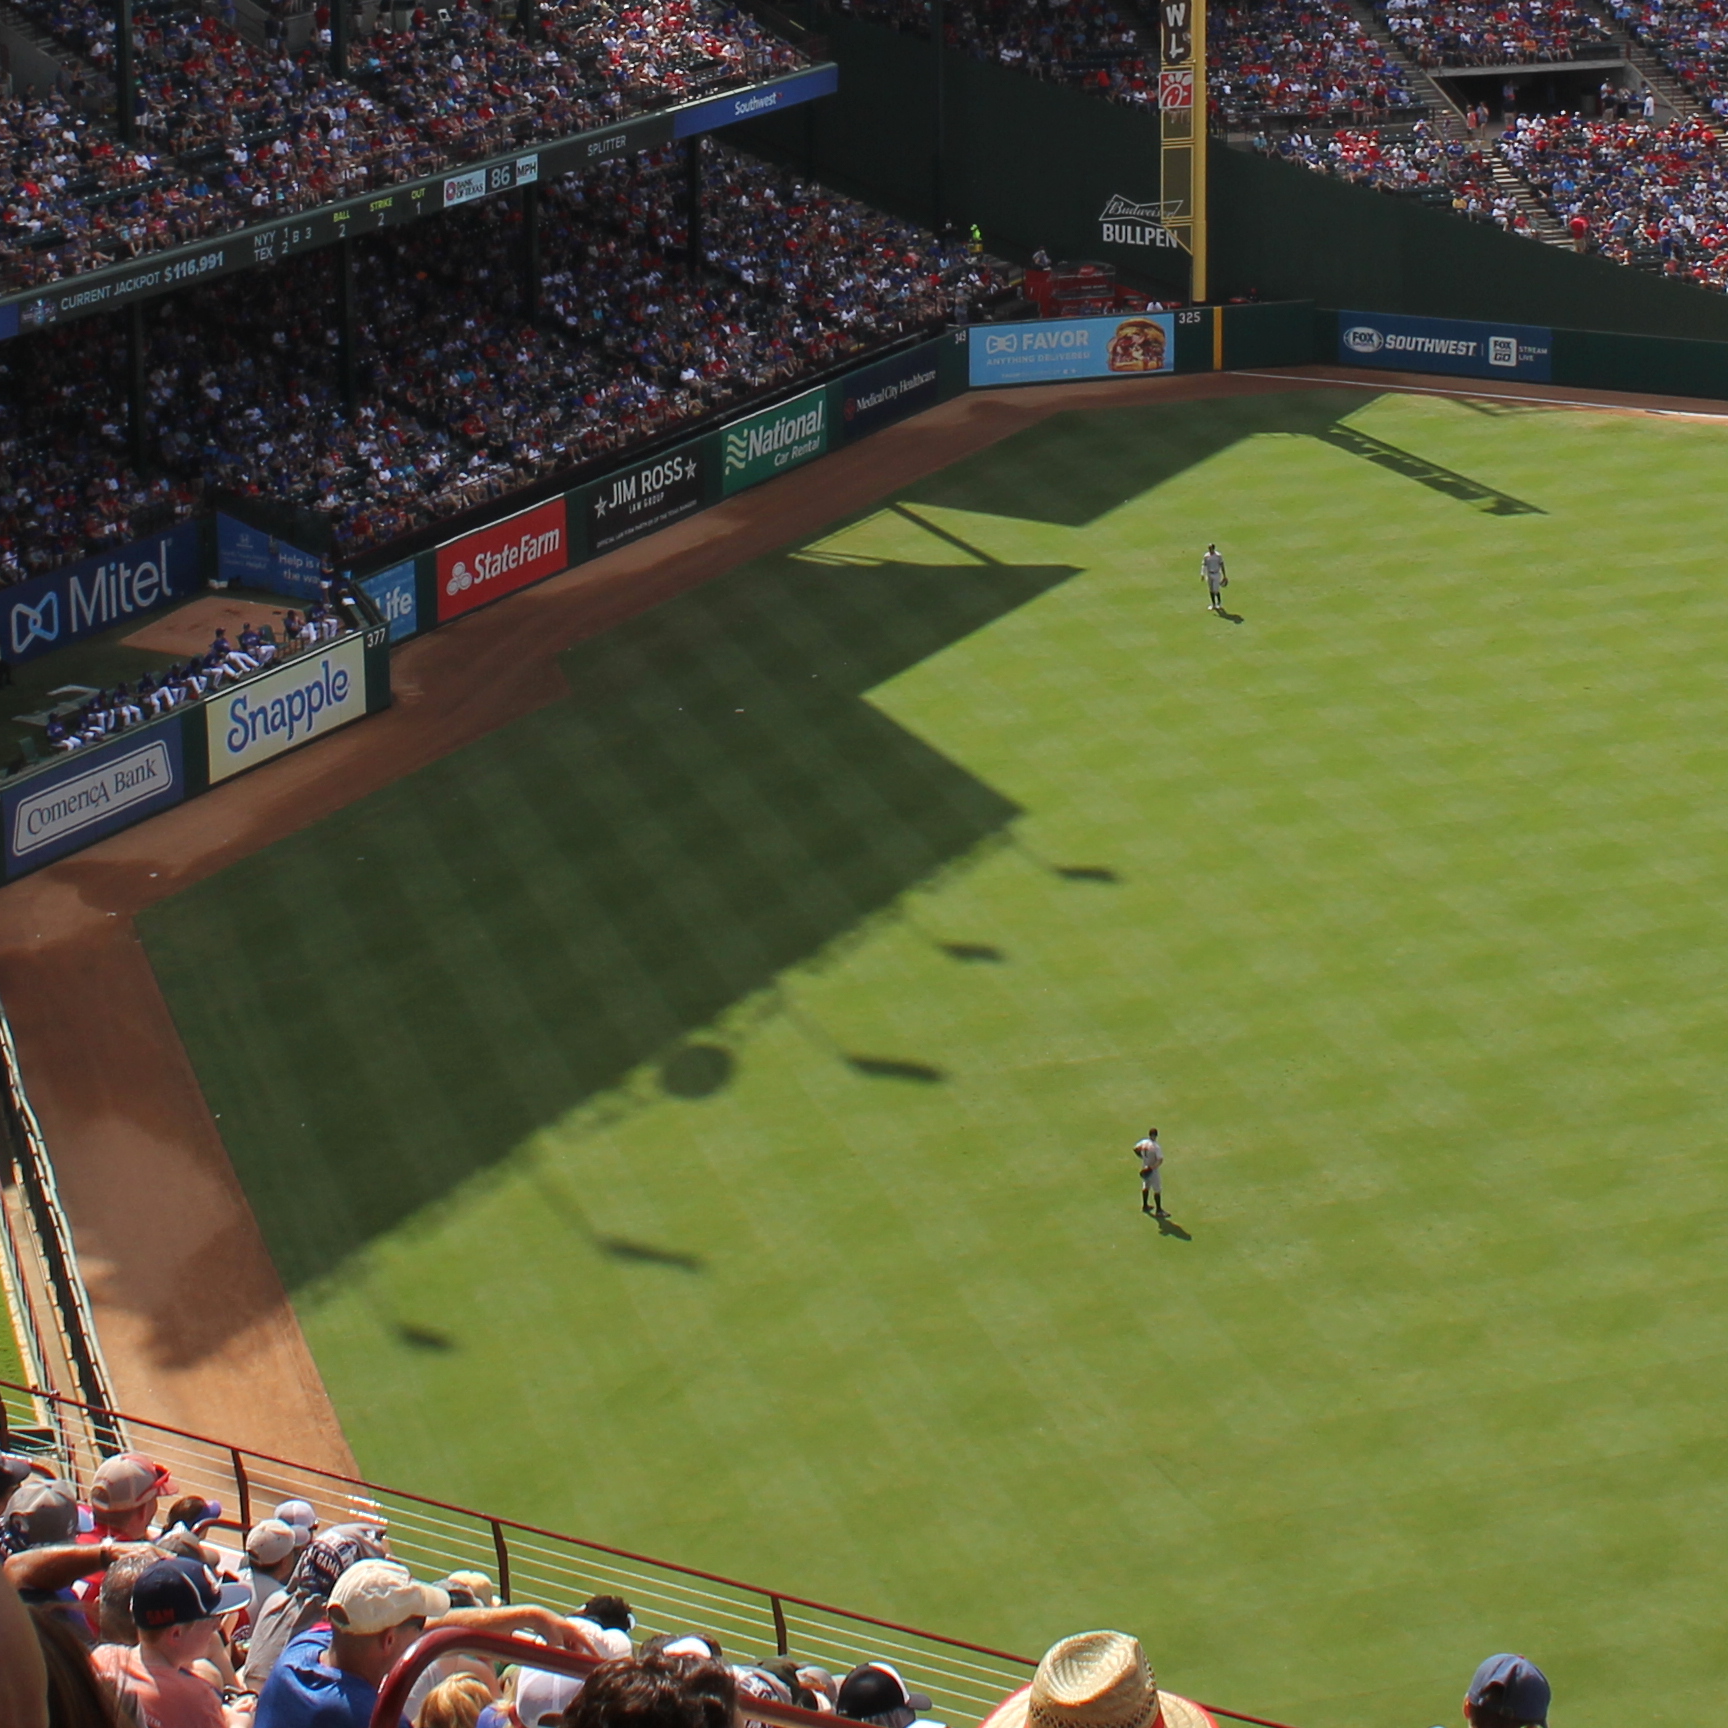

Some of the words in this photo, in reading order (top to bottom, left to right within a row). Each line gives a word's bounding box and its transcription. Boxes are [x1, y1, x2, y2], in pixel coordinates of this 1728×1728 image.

[735, 92, 776, 115] Southwest
[587, 135, 625, 157] SPLITTER
[491, 169, 510, 188] 86
[517, 162, 536, 178] MPH
[1102, 223, 1177, 248] BULLPEN
[61, 285, 110, 311] CURRENT
[113, 272, 159, 296] JACKPOT
[164, 251, 222, 283] $116,991
[1179, 312, 1201, 324] 325
[1023, 329, 1088, 350] FAVOR
[1385, 334, 1476, 356] SOUTHWEST
[857, 388, 883, 412] Medical
[884, 385, 898, 400] City
[899, 370, 935, 390] Healthcare
[748, 400, 823, 461] National
[774, 450, 789, 467] Car
[791, 437, 819, 457] Rental
[609, 475, 635, 509] JIM
[641, 457, 682, 494] ROSS
[629, 503, 641, 515] LAW
[644, 492, 664, 508] GROUP
[473, 527, 560, 584] StateFarm
[70, 540, 173, 634] Mitel
[366, 626, 387, 649] 377
[225, 659, 349, 755] Snapple
[114, 758, 156, 794] Bank
